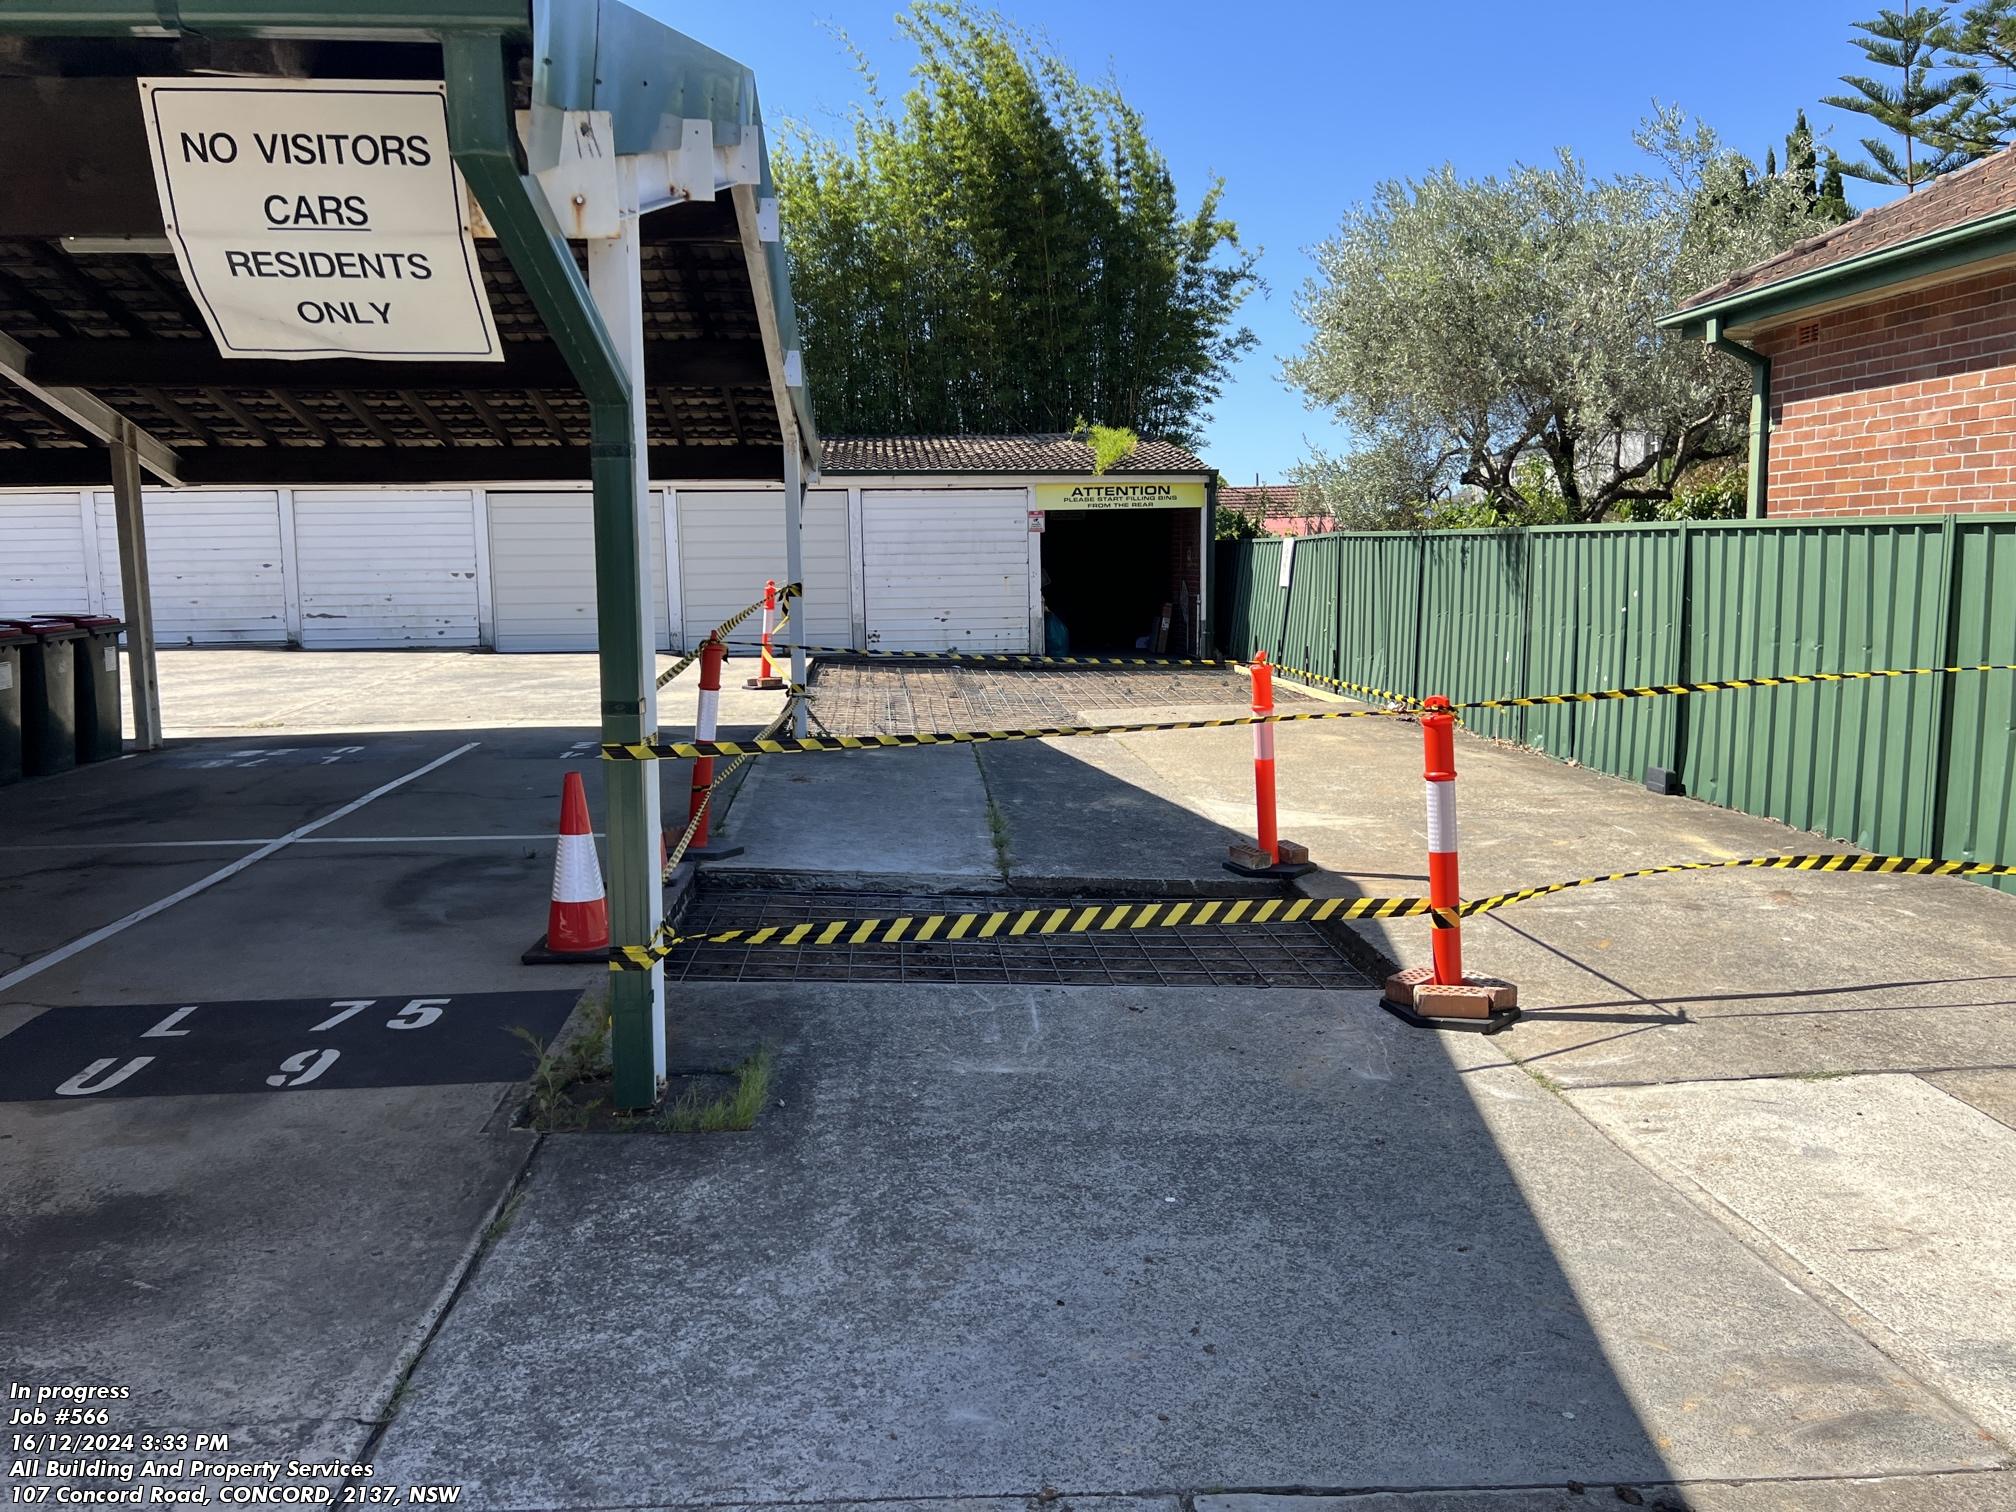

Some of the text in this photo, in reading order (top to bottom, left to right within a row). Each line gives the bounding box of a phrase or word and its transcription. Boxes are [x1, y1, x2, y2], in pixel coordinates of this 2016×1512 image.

[180, 132, 431, 167] NO VISITORS
[264, 195, 369, 226] CARS
[225, 250, 432, 280] RESIDENTS
[297, 302, 391, 325] ONLY
[1071, 485, 1171, 497] ATTENTION
[140, 1006, 199, 1038] L
[54, 1048, 342, 1096] U 9
